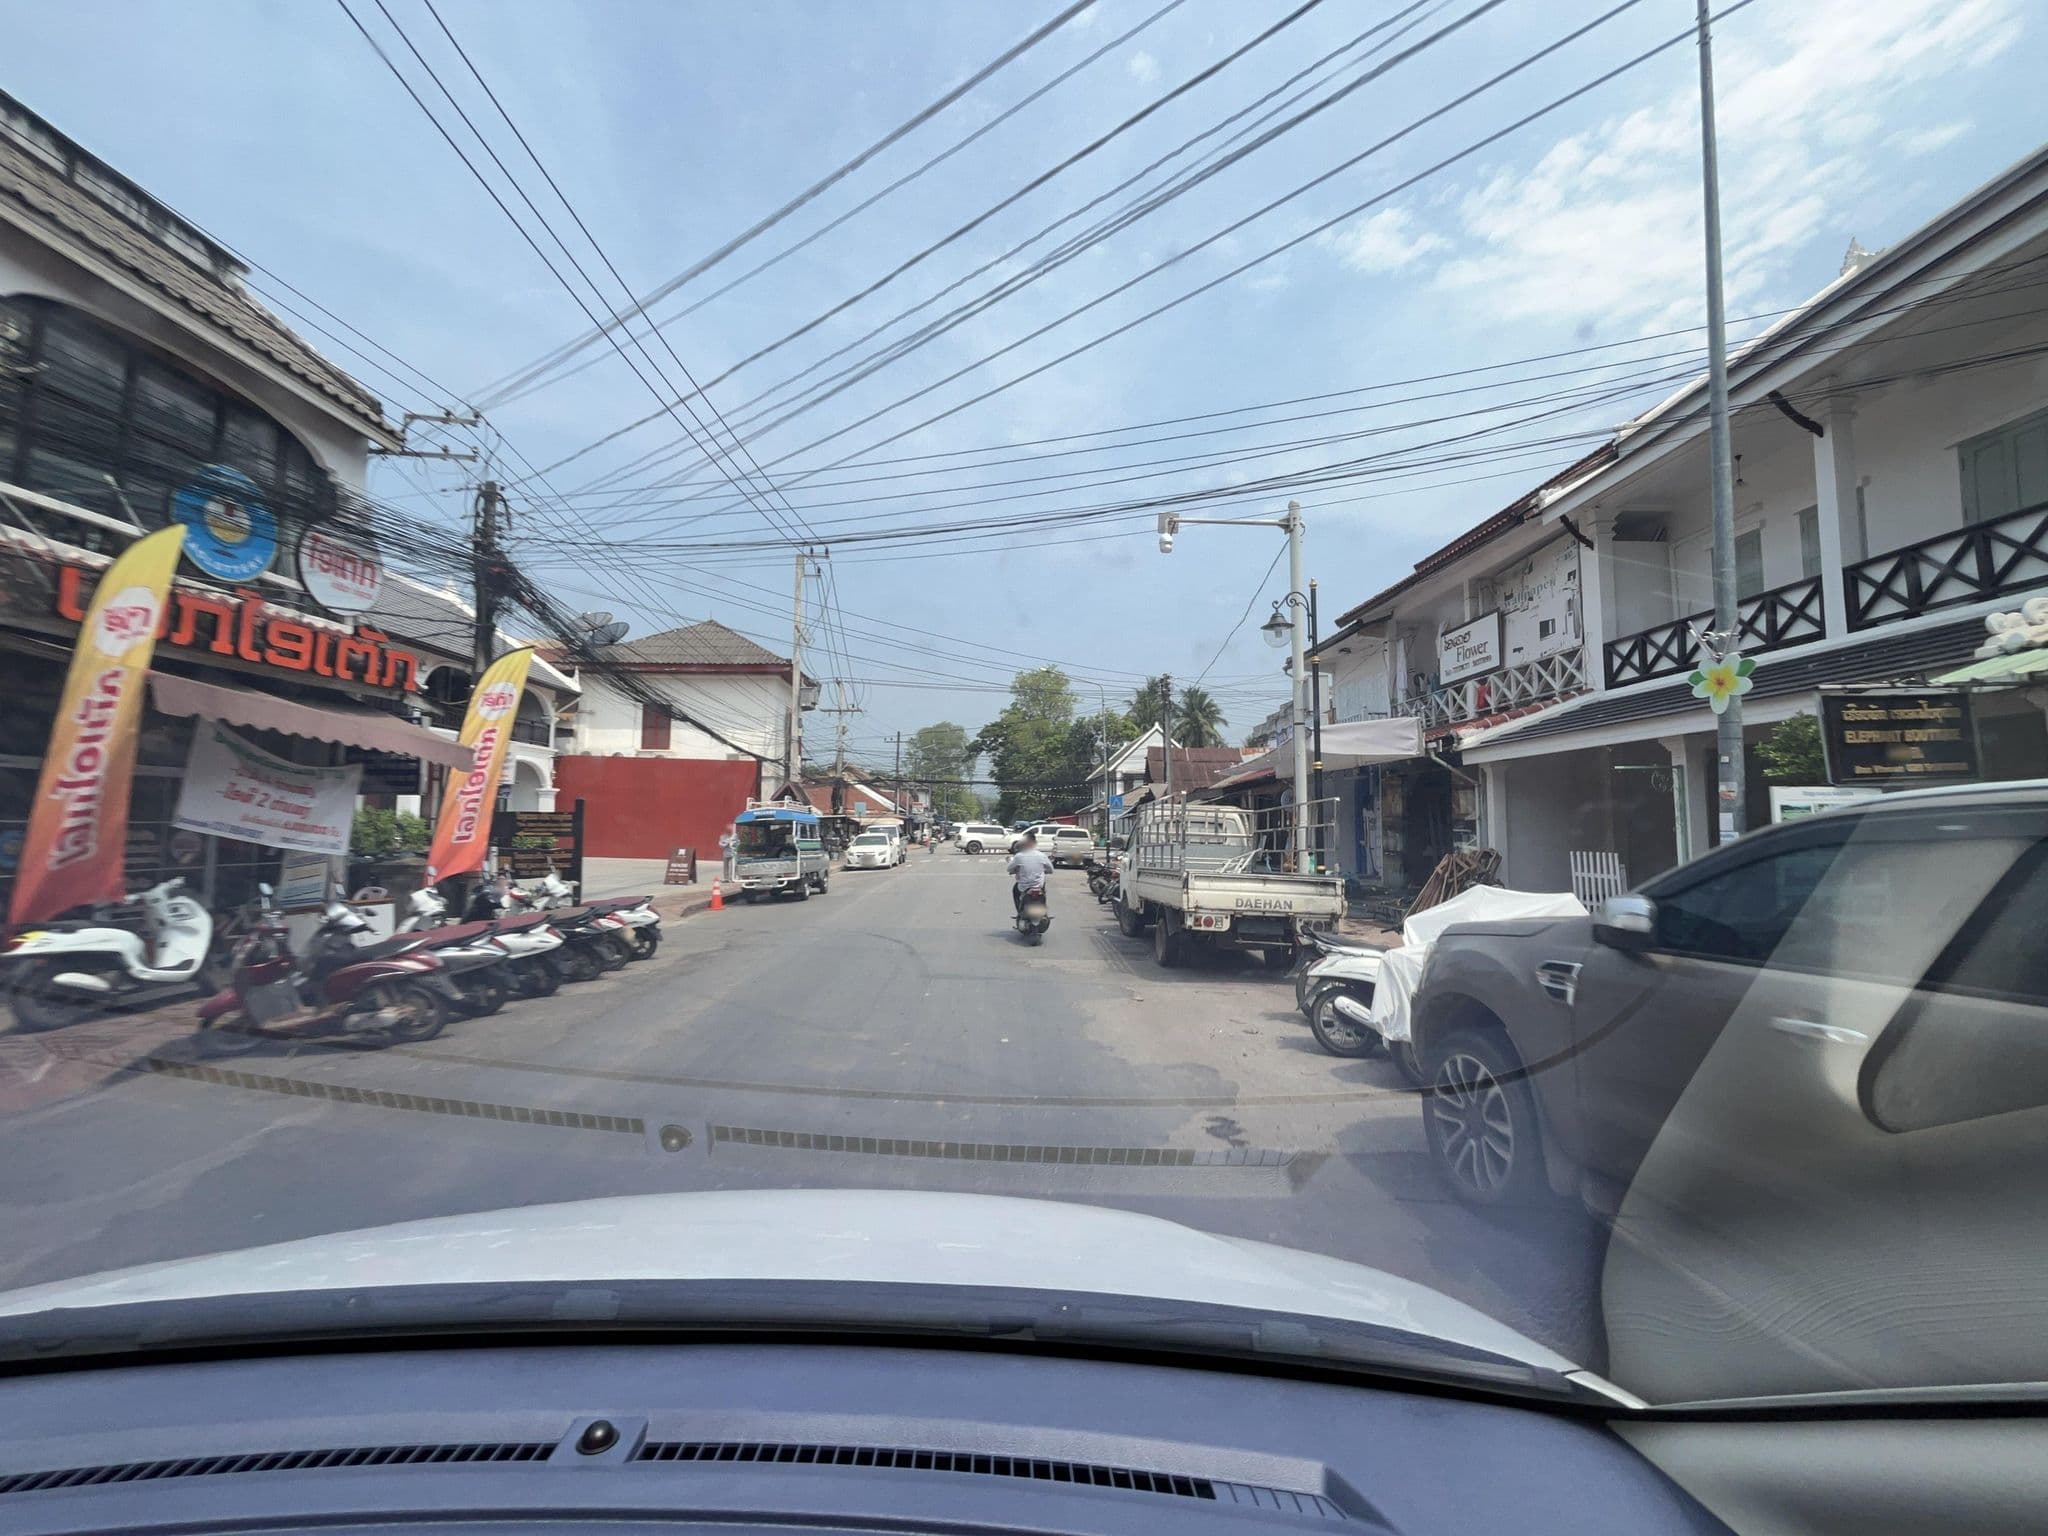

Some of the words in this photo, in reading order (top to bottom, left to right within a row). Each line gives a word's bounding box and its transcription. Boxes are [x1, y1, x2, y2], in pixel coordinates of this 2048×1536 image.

[57, 565, 418, 693] ເກໄອເຕັກ
[1456, 641, 1489, 663] Flower
[1236, 898, 1293, 910] DAEHAN
